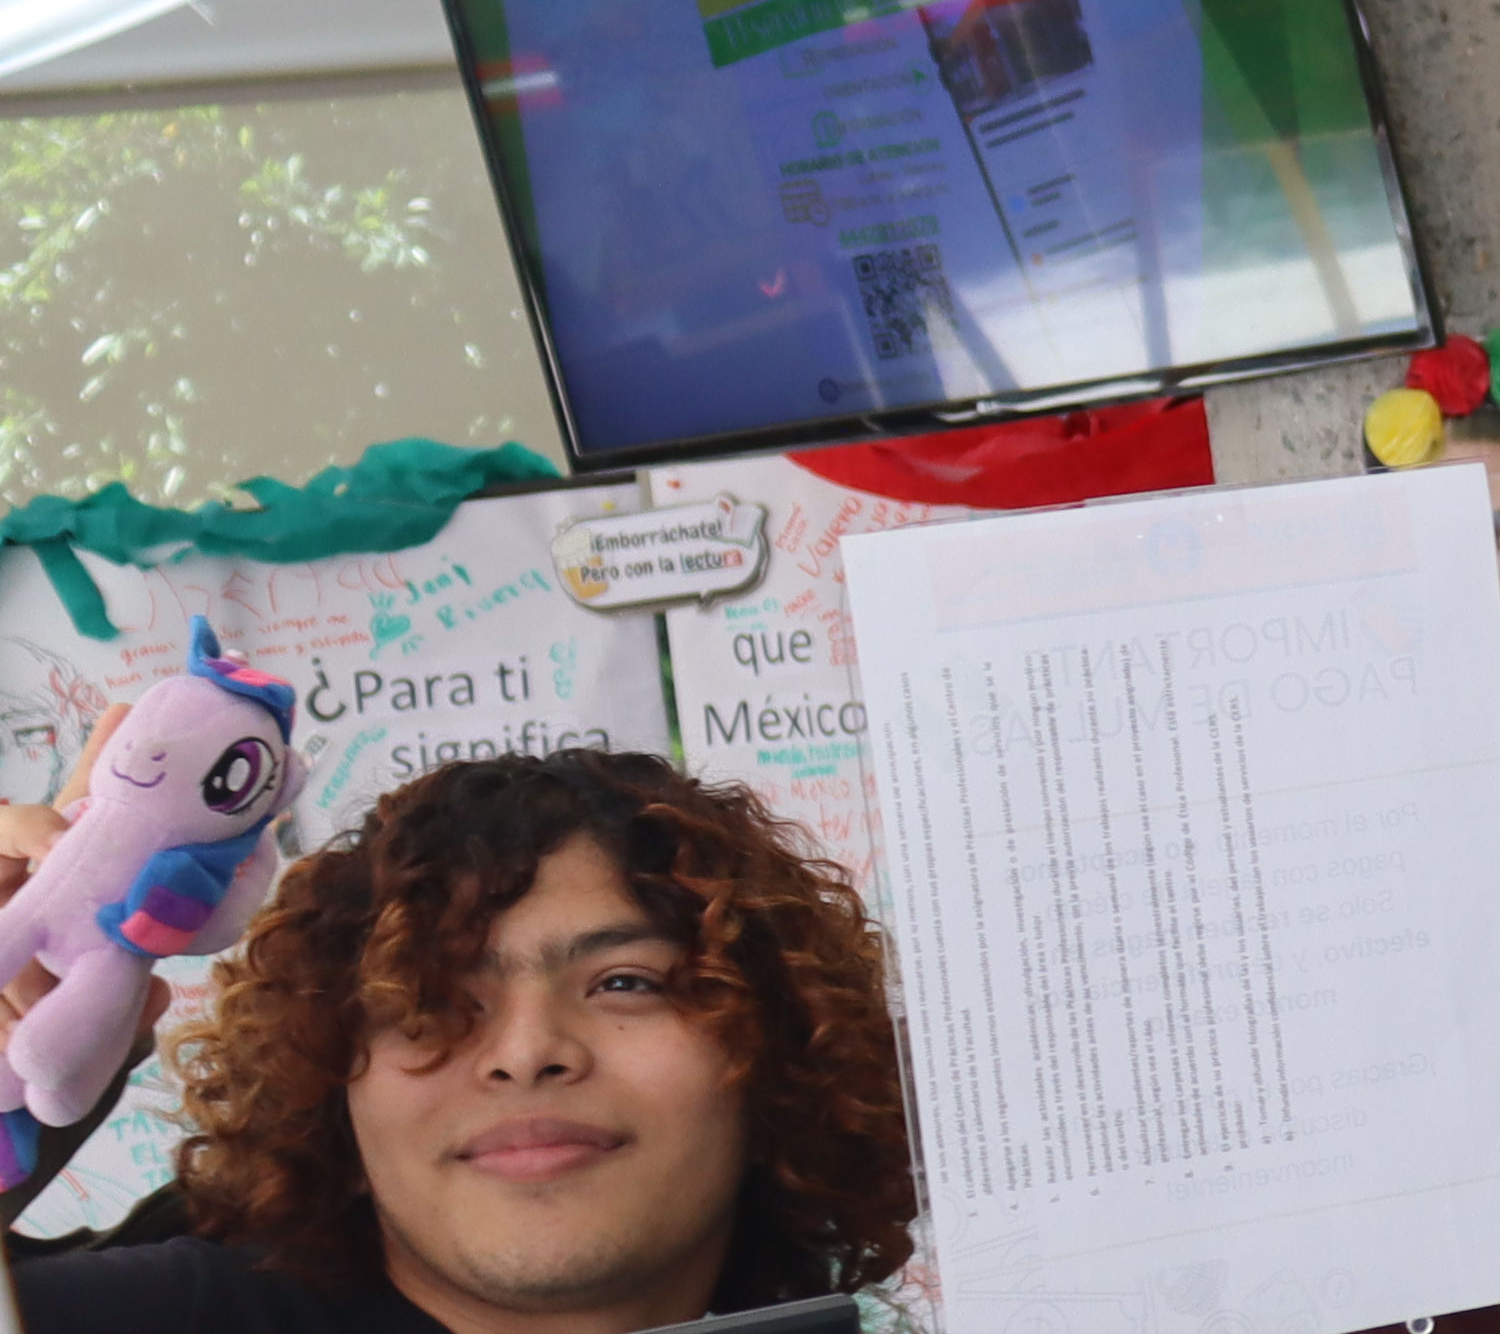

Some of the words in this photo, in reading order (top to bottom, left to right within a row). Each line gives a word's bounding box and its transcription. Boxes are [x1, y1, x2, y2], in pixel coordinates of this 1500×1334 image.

[589, 520, 723, 552] ¡Emborráchate!
[580, 565, 620, 583] Pero
[624, 560, 653, 578] con
[658, 556, 675, 573] la
[679, 549, 744, 573] lectura
[732, 628, 814, 675] que
[306, 655, 475, 724] ¿Para
[496, 655, 531, 703] ti
[703, 691, 868, 747] México
